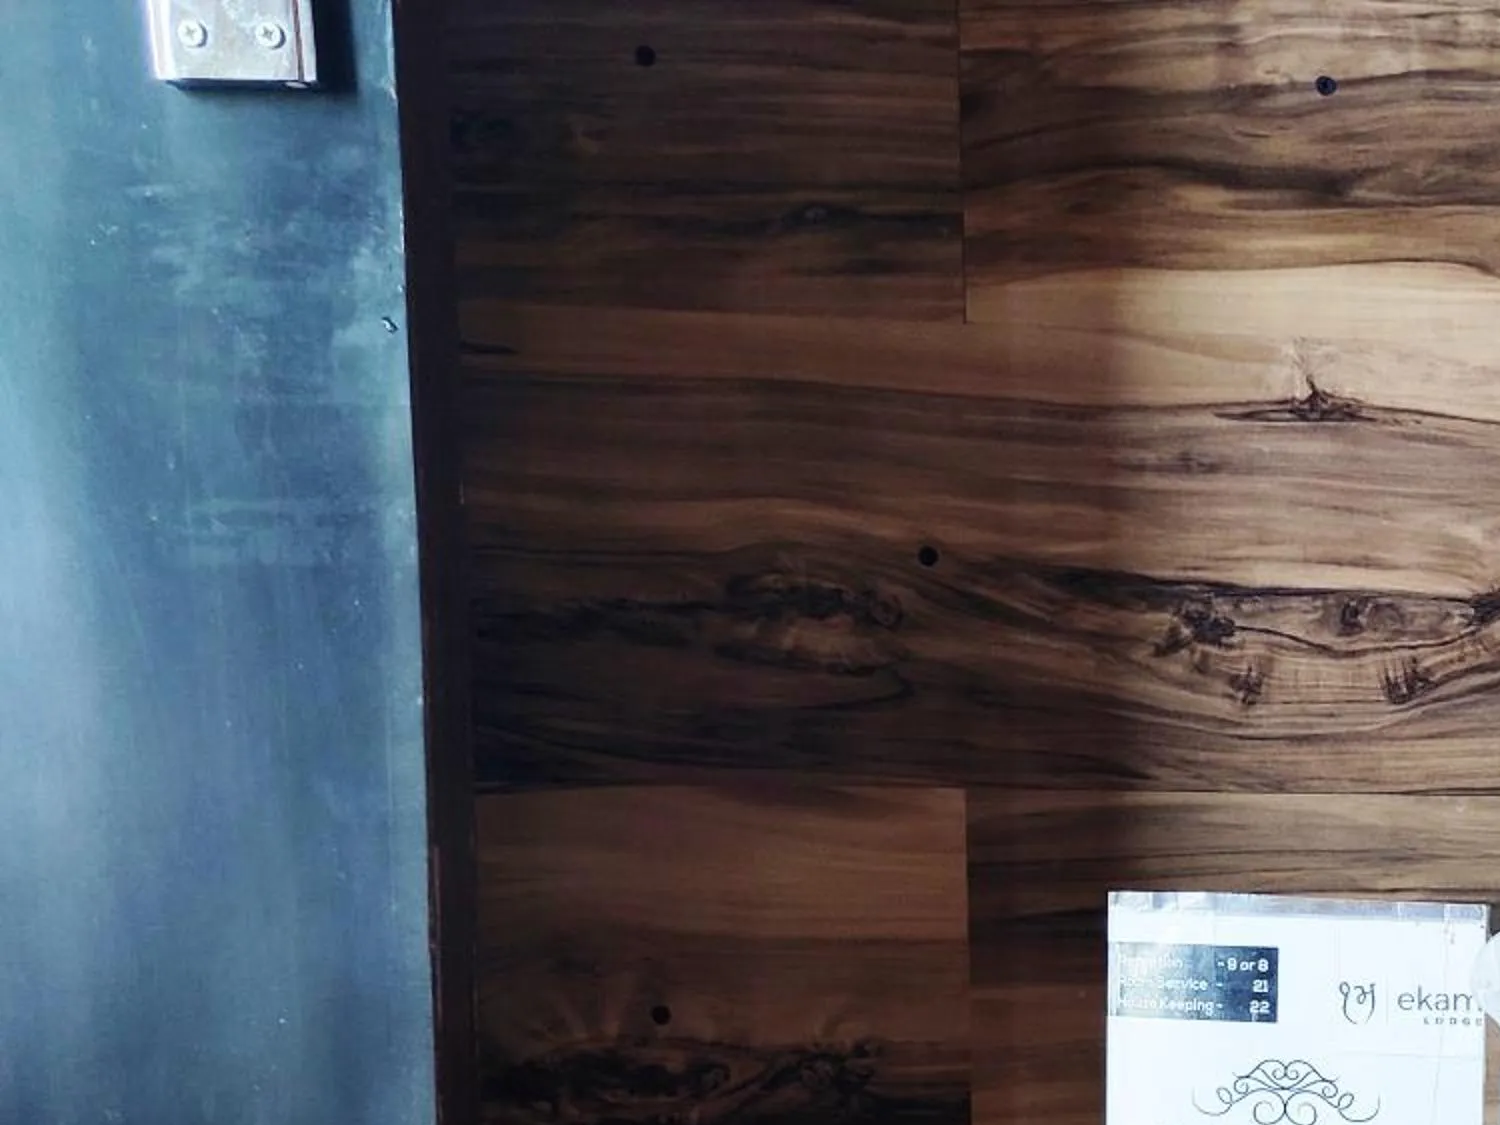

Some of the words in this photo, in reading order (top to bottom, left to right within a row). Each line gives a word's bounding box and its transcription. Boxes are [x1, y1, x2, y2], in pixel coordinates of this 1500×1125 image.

[1240, 961, 1256, 971] or
[1252, 979, 1268, 993] 21
[1250, 1000, 1270, 1013] 22
